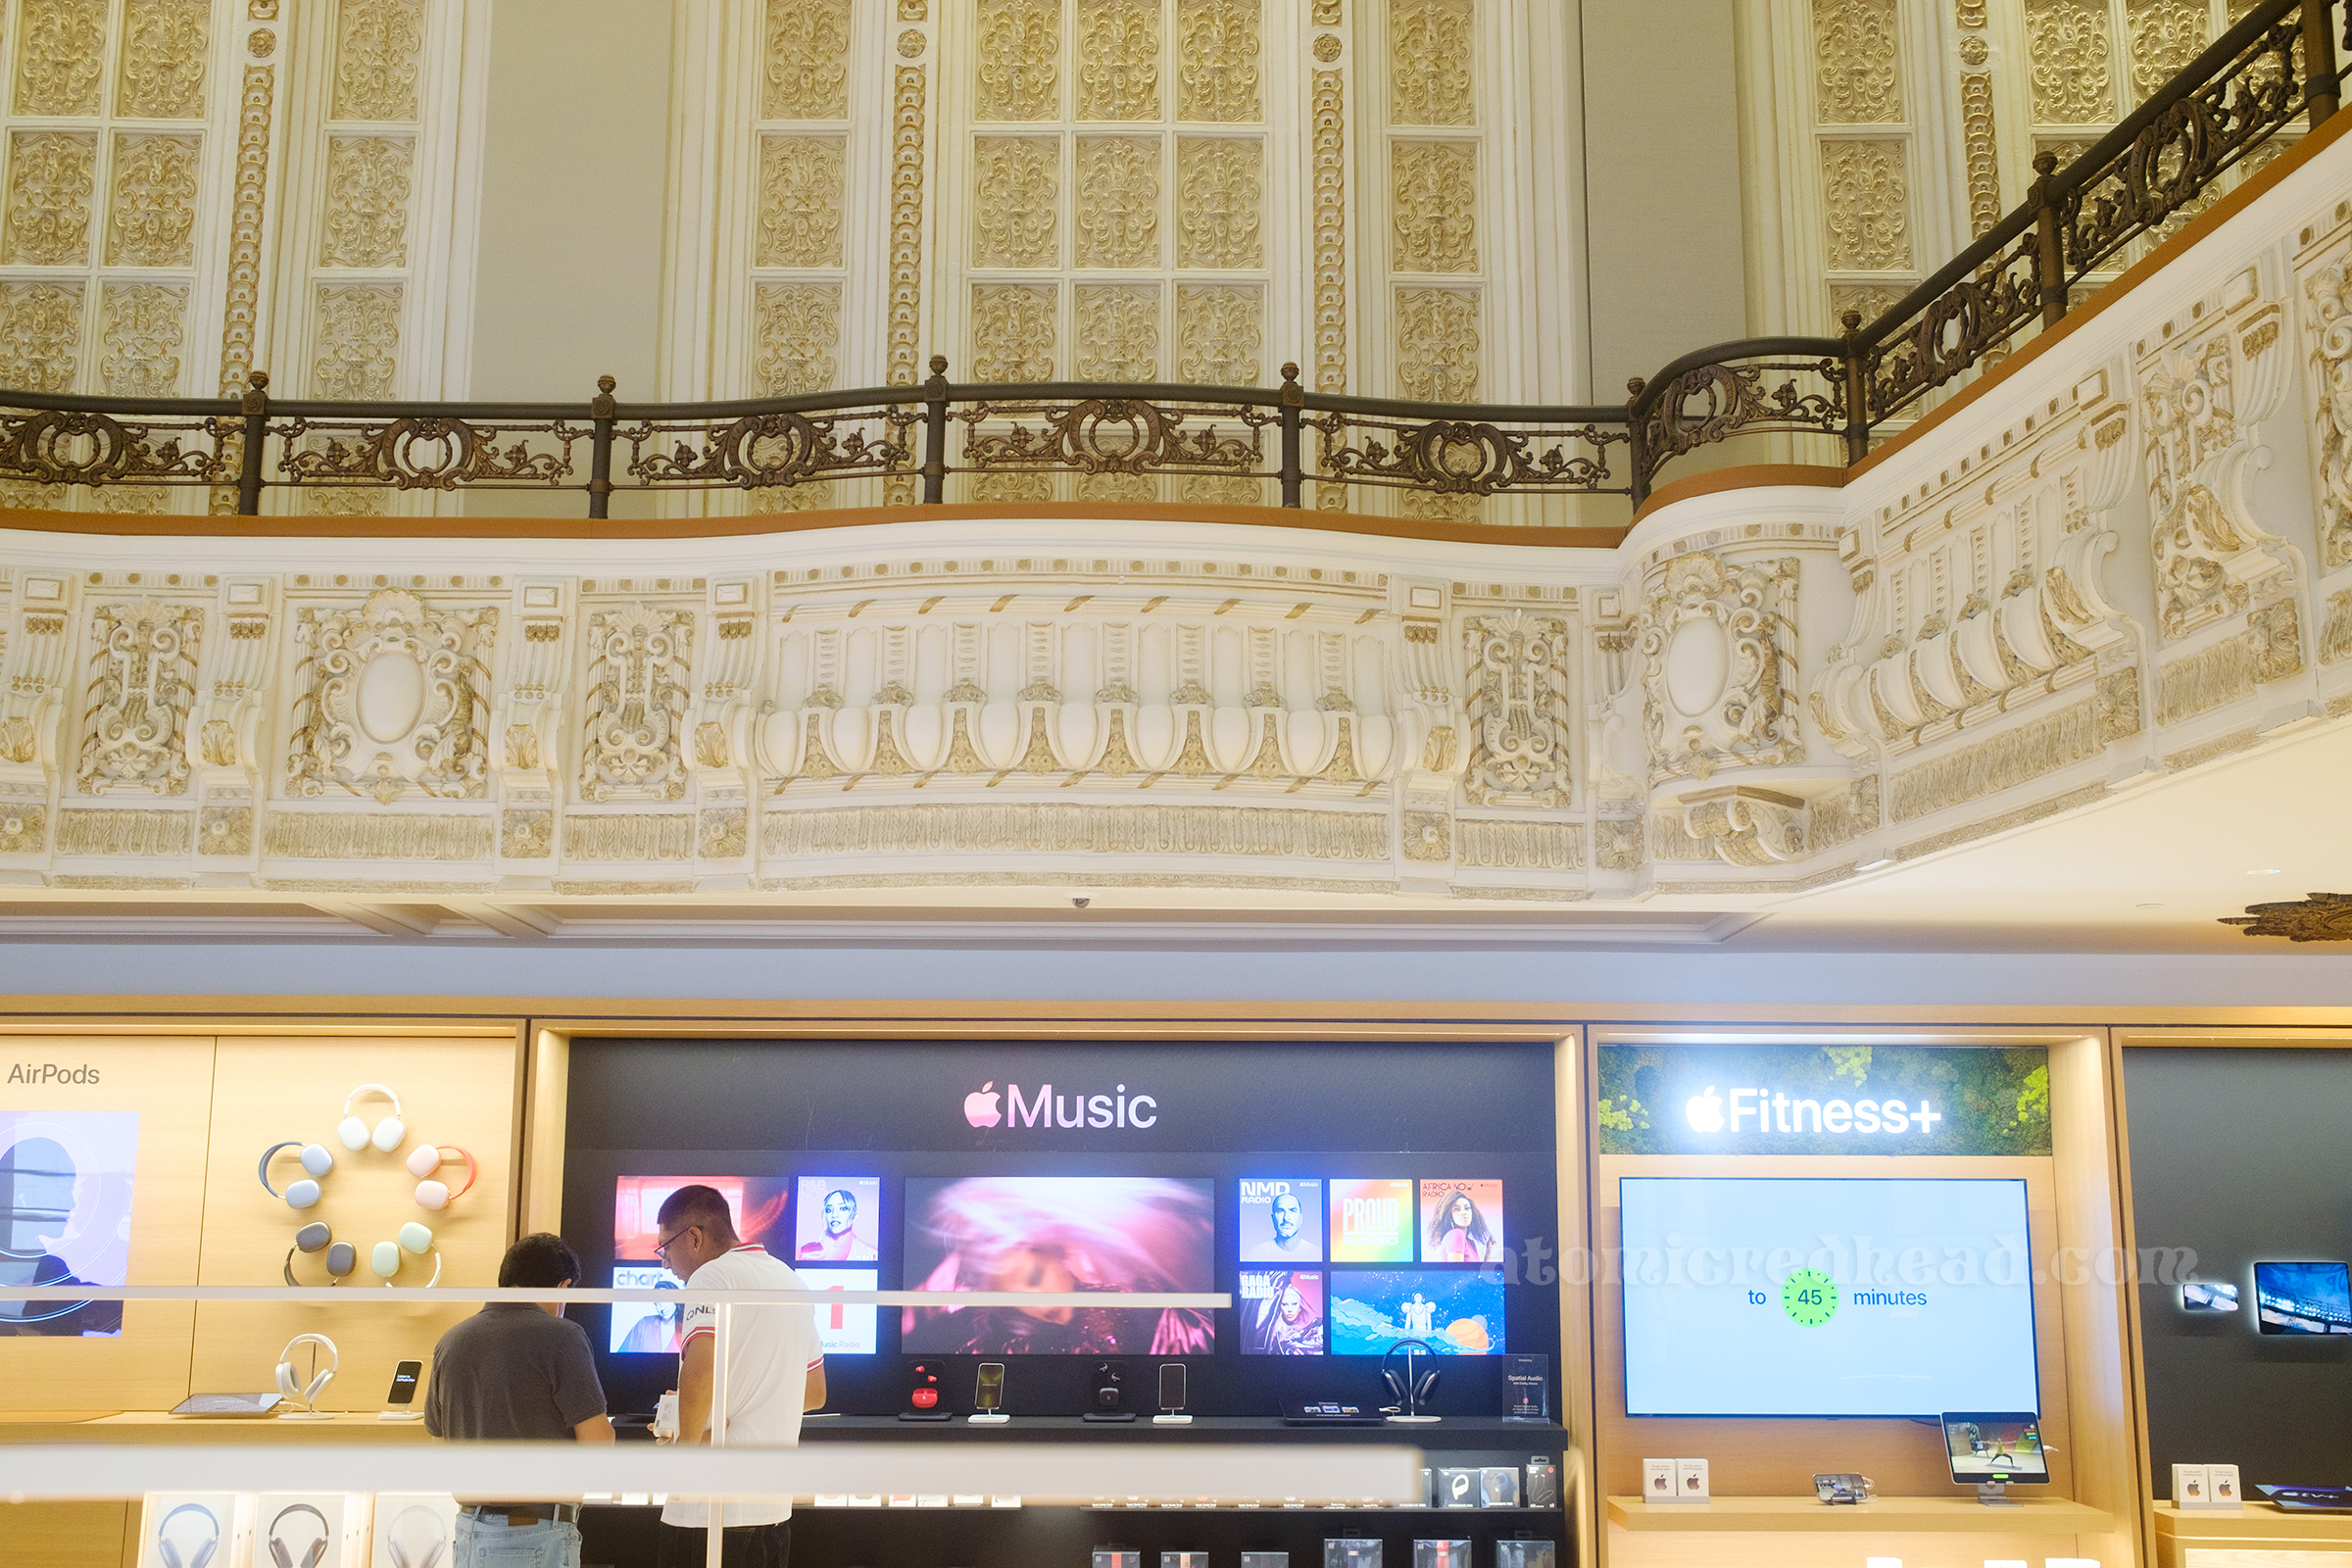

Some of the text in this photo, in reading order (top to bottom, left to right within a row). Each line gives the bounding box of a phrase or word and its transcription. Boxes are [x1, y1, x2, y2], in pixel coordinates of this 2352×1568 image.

[7, 1063, 100, 1084] AirPods
[1007, 1084, 1157, 1128] Music
[1729, 1088, 1941, 1133] Fitness+
[1241, 1182, 1290, 1196] NMD
[1343, 1198, 1398, 1231] PROUD
[1343, 1237, 1399, 1246] RADIO
[616, 1270, 663, 1286] chart
[1242, 1275, 1270, 1286] GAGA
[1242, 1287, 1274, 1298] RADIO
[1748, 1289, 1928, 1305] to 45 minutes
